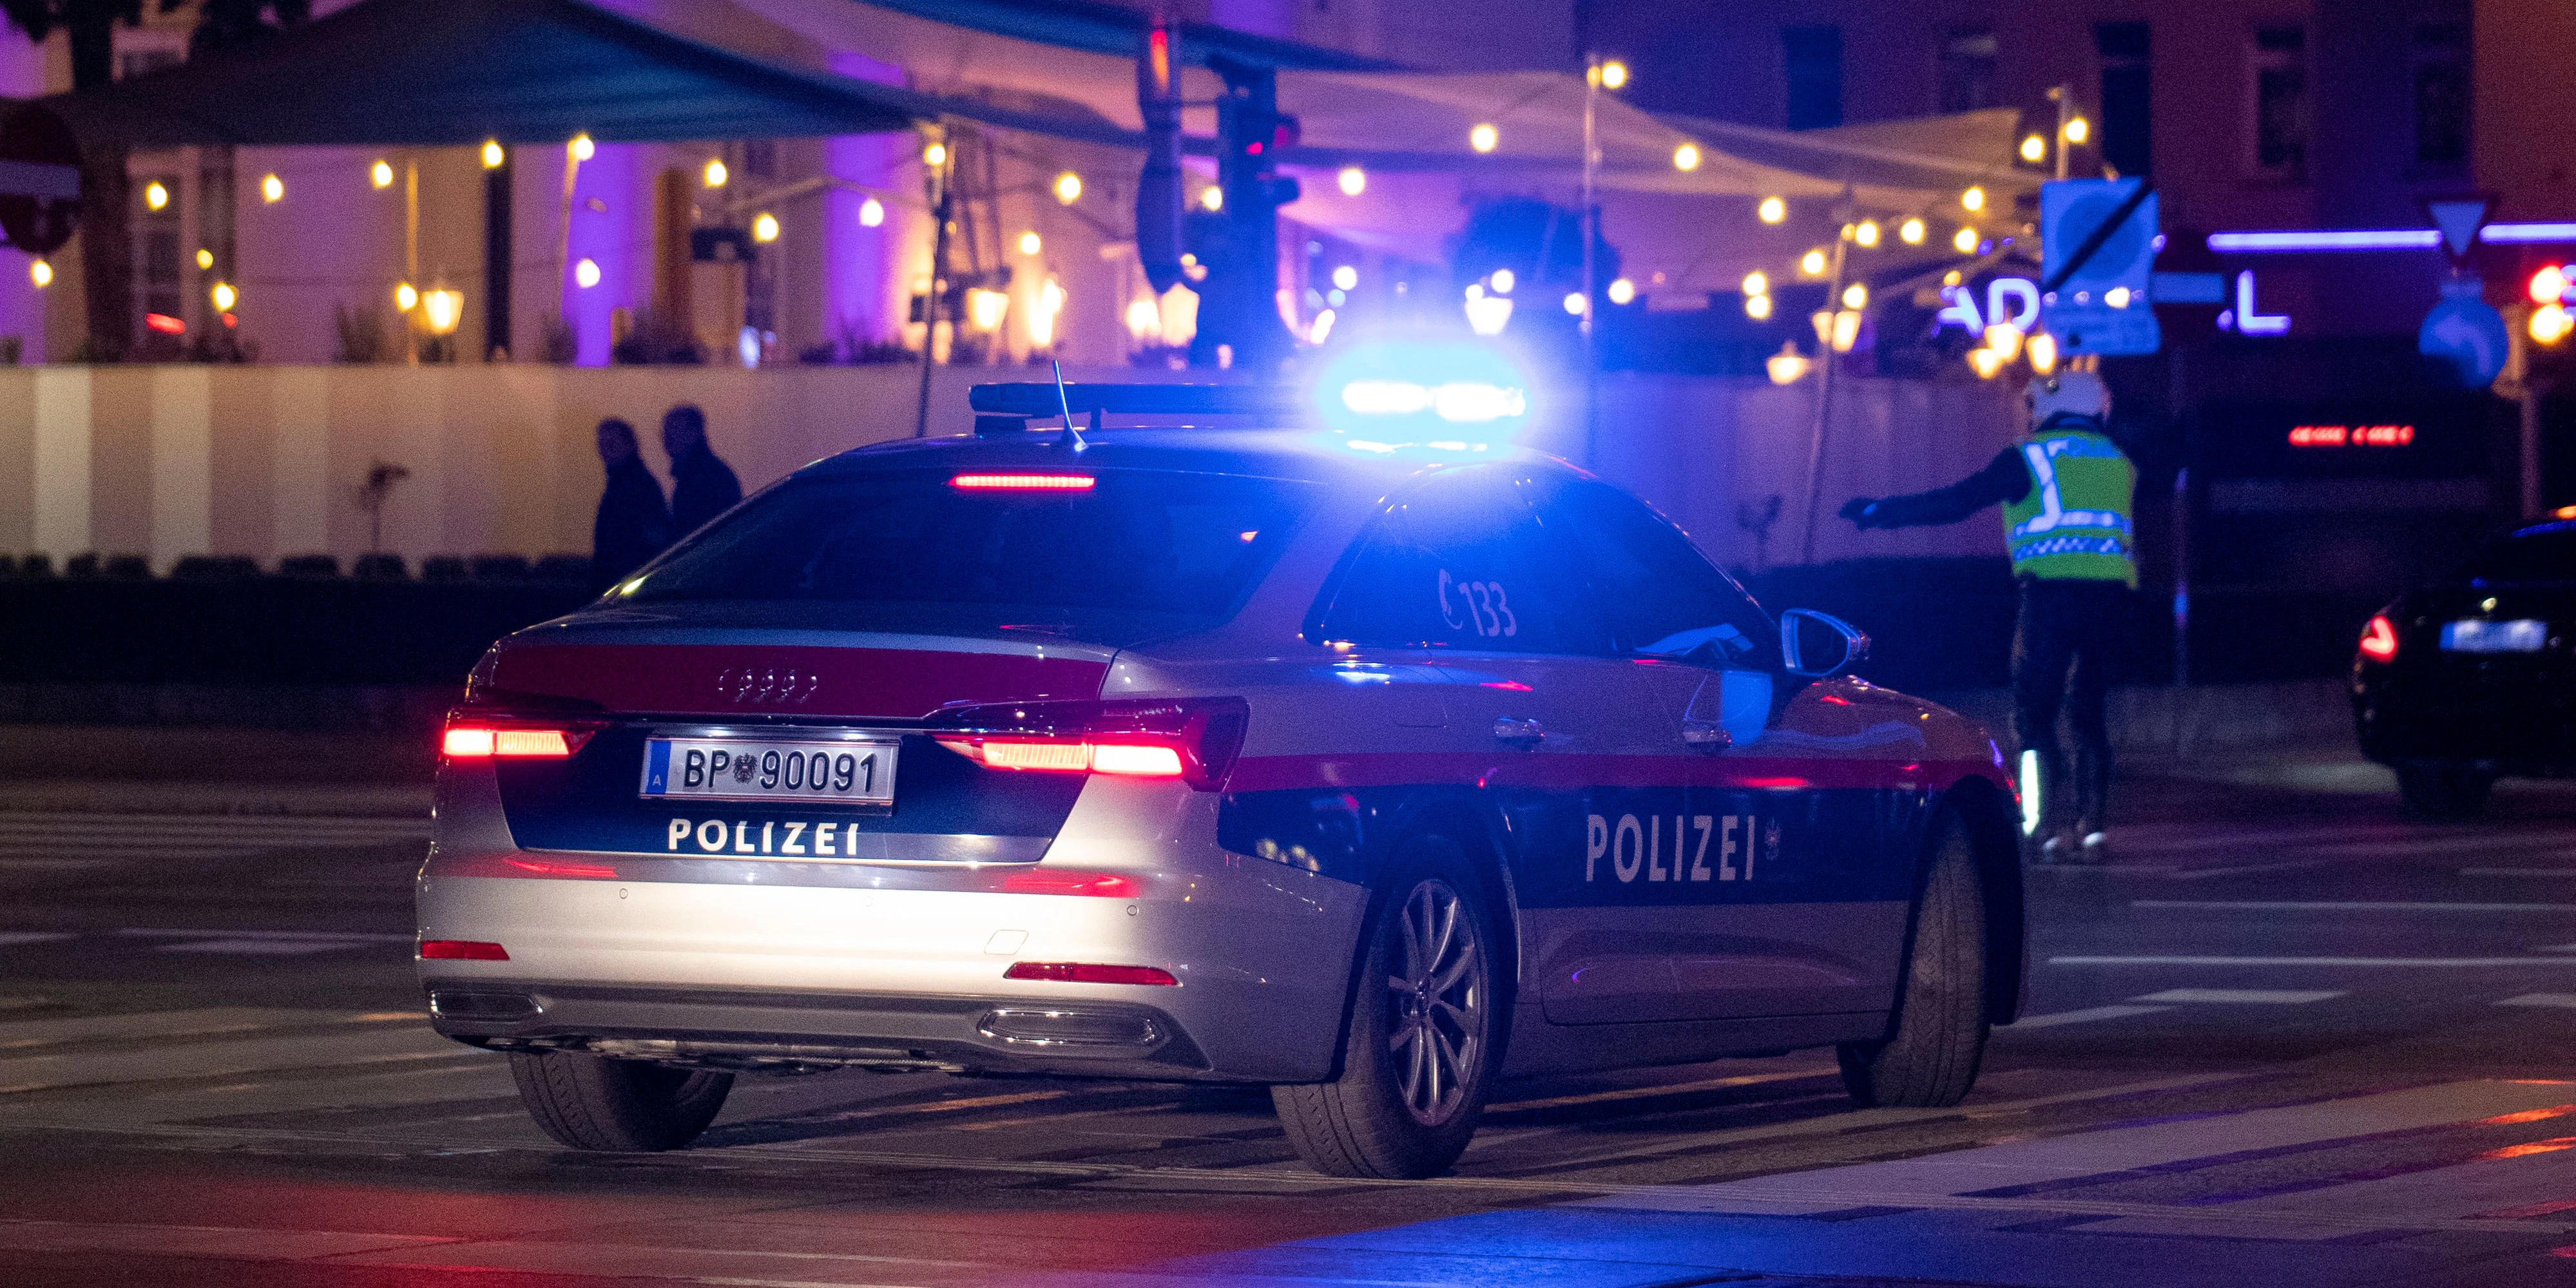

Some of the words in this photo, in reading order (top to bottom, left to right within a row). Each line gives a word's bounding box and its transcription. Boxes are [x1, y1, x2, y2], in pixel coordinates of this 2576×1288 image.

[1457, 581, 1517, 637] 133
[652, 775, 662, 787] A
[684, 749, 730, 788] BP
[759, 750, 876, 793] 90091
[668, 818, 859, 856] POLIZEI
[1586, 813, 1756, 883] POLIZEI
